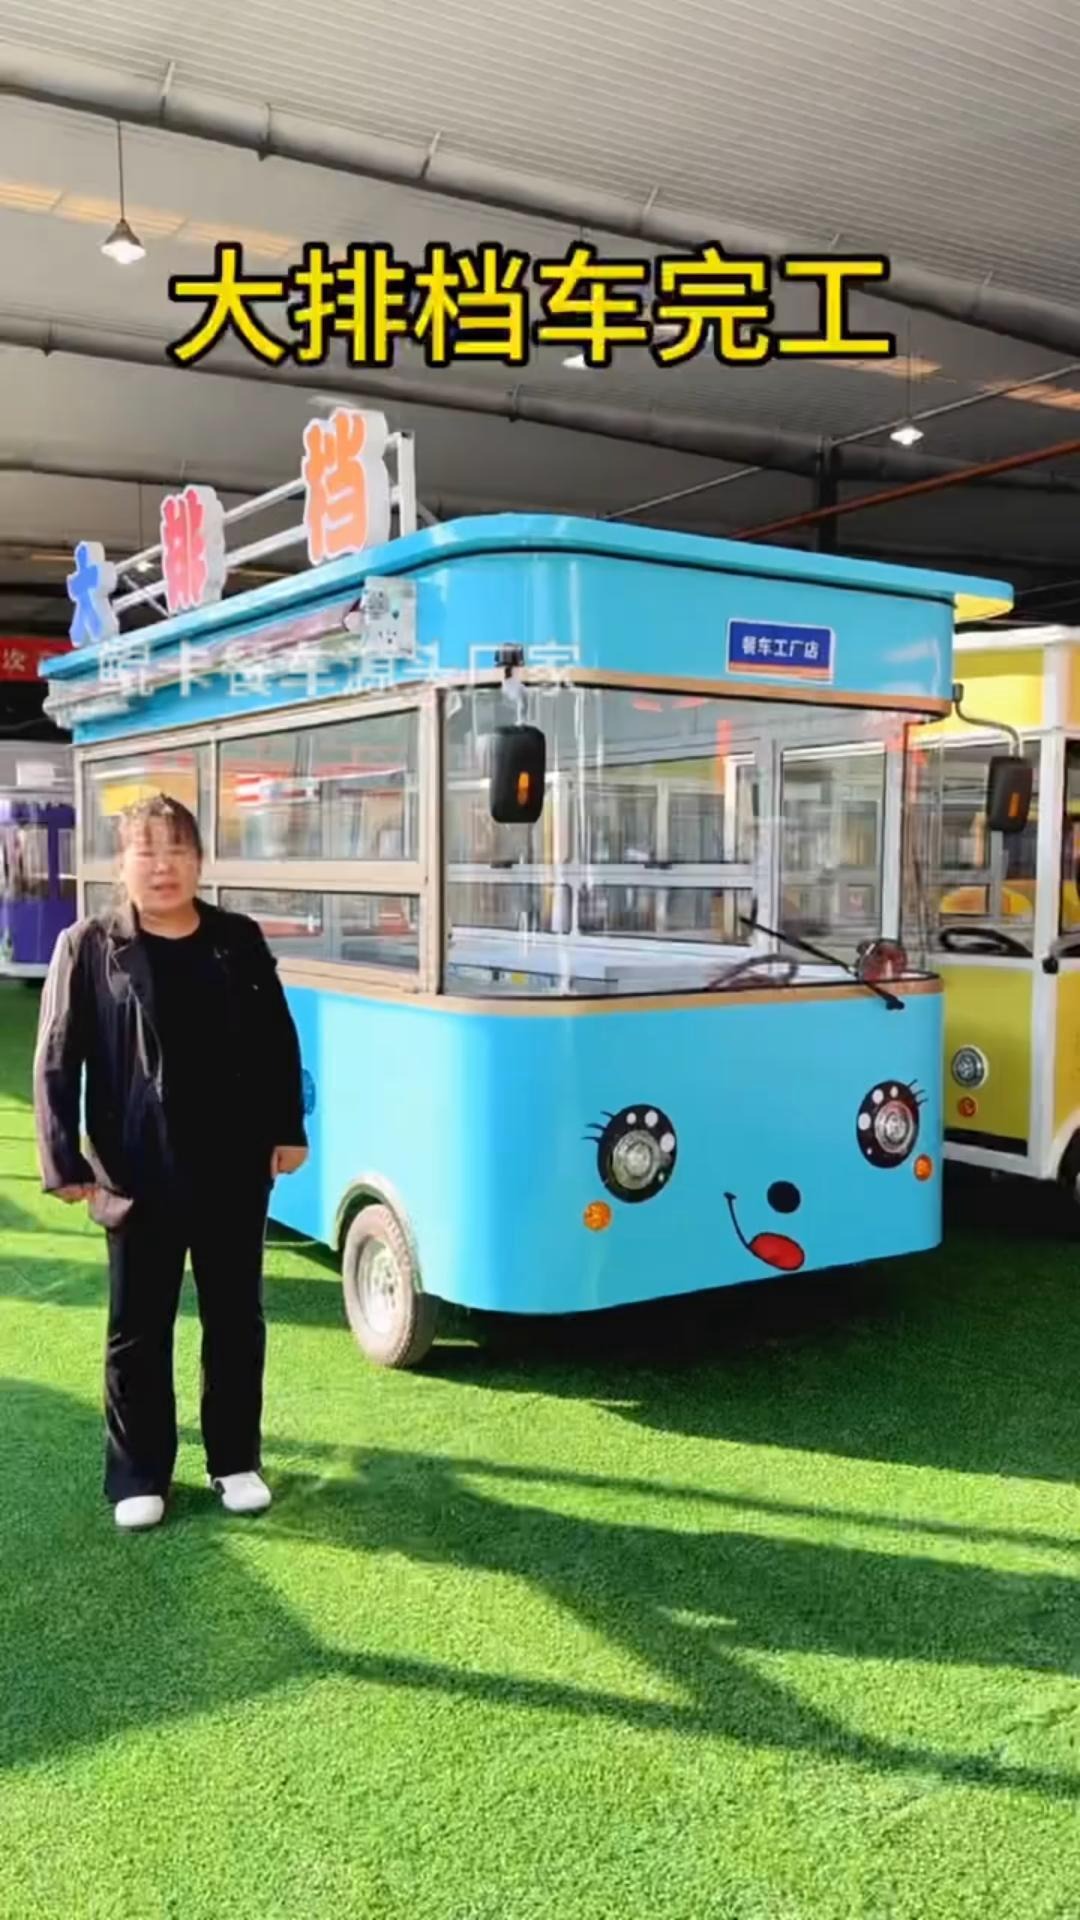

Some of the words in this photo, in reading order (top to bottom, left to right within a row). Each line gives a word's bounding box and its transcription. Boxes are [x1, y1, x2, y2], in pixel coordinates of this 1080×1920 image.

[67, 408, 368, 647] 大排档
[742, 635, 820, 659] 餐车工厂店
